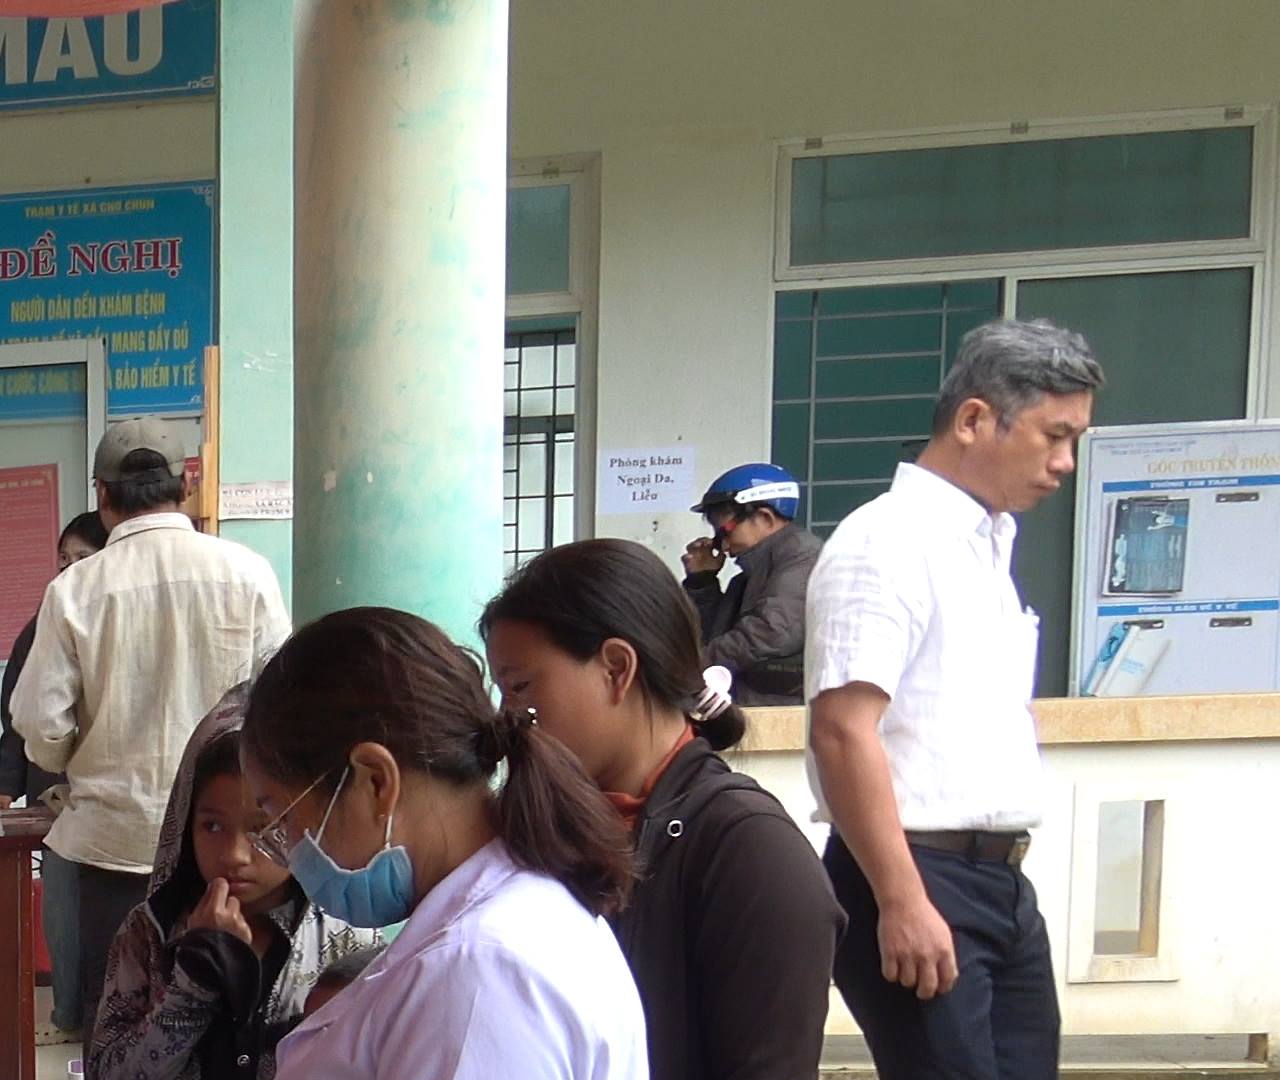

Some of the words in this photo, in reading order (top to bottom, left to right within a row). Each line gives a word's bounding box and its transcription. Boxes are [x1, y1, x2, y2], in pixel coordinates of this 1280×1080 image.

[68, 236, 183, 278] NGHỊ
[11, 295, 45, 322] NGƯỜI
[48, 294, 70, 320] DÂN
[99, 291, 132, 317] KHÁM
[135, 288, 165, 319] BỆNH
[112, 330, 145, 352] MANG
[173, 365, 180, 386] Y
[609, 457, 647, 468] Phòng
[649, 456, 683, 465] khám
[1241, 449, 1280, 469] THÔN
[617, 474, 651, 486] Ngoại
